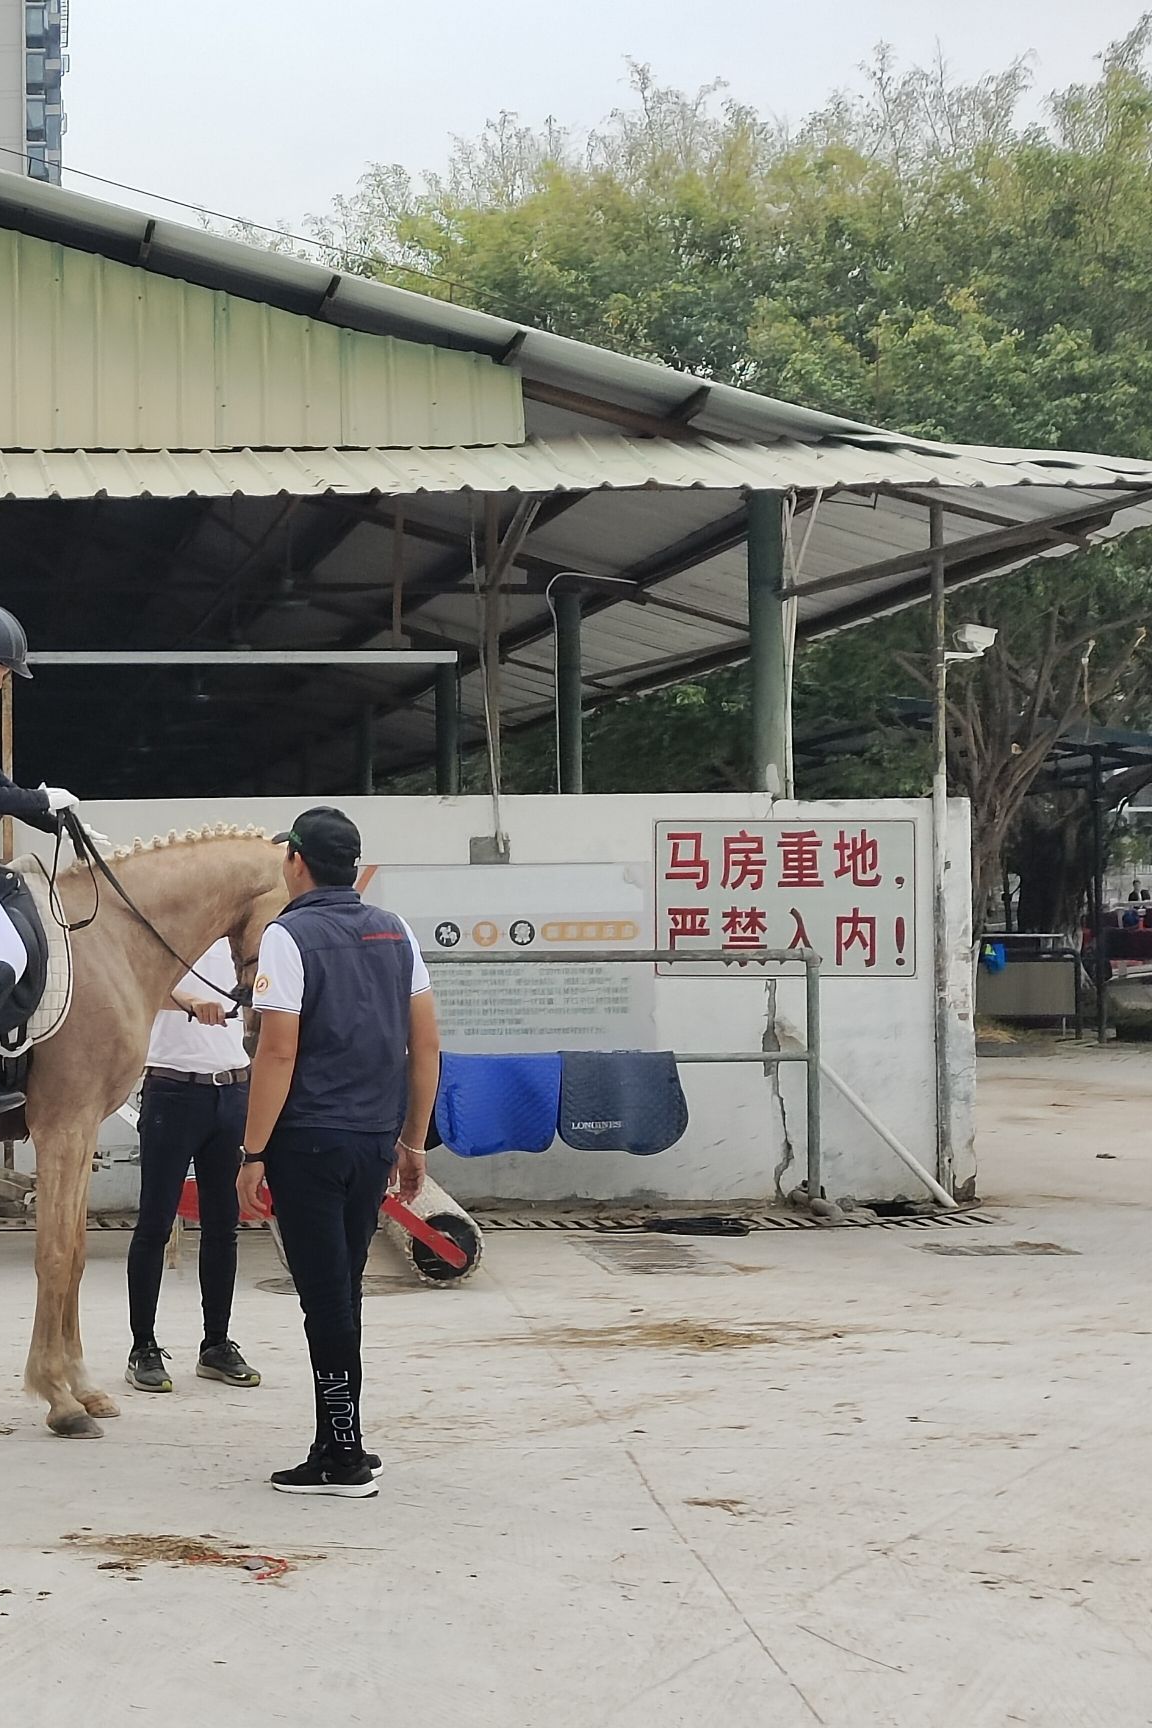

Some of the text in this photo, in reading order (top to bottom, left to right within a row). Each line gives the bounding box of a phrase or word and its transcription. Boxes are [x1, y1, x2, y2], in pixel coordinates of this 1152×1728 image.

[665, 828, 906, 890] 马房重地，
[571, 1120, 623, 1130] LONGINES
[316, 1370, 356, 1443] EQUINE
